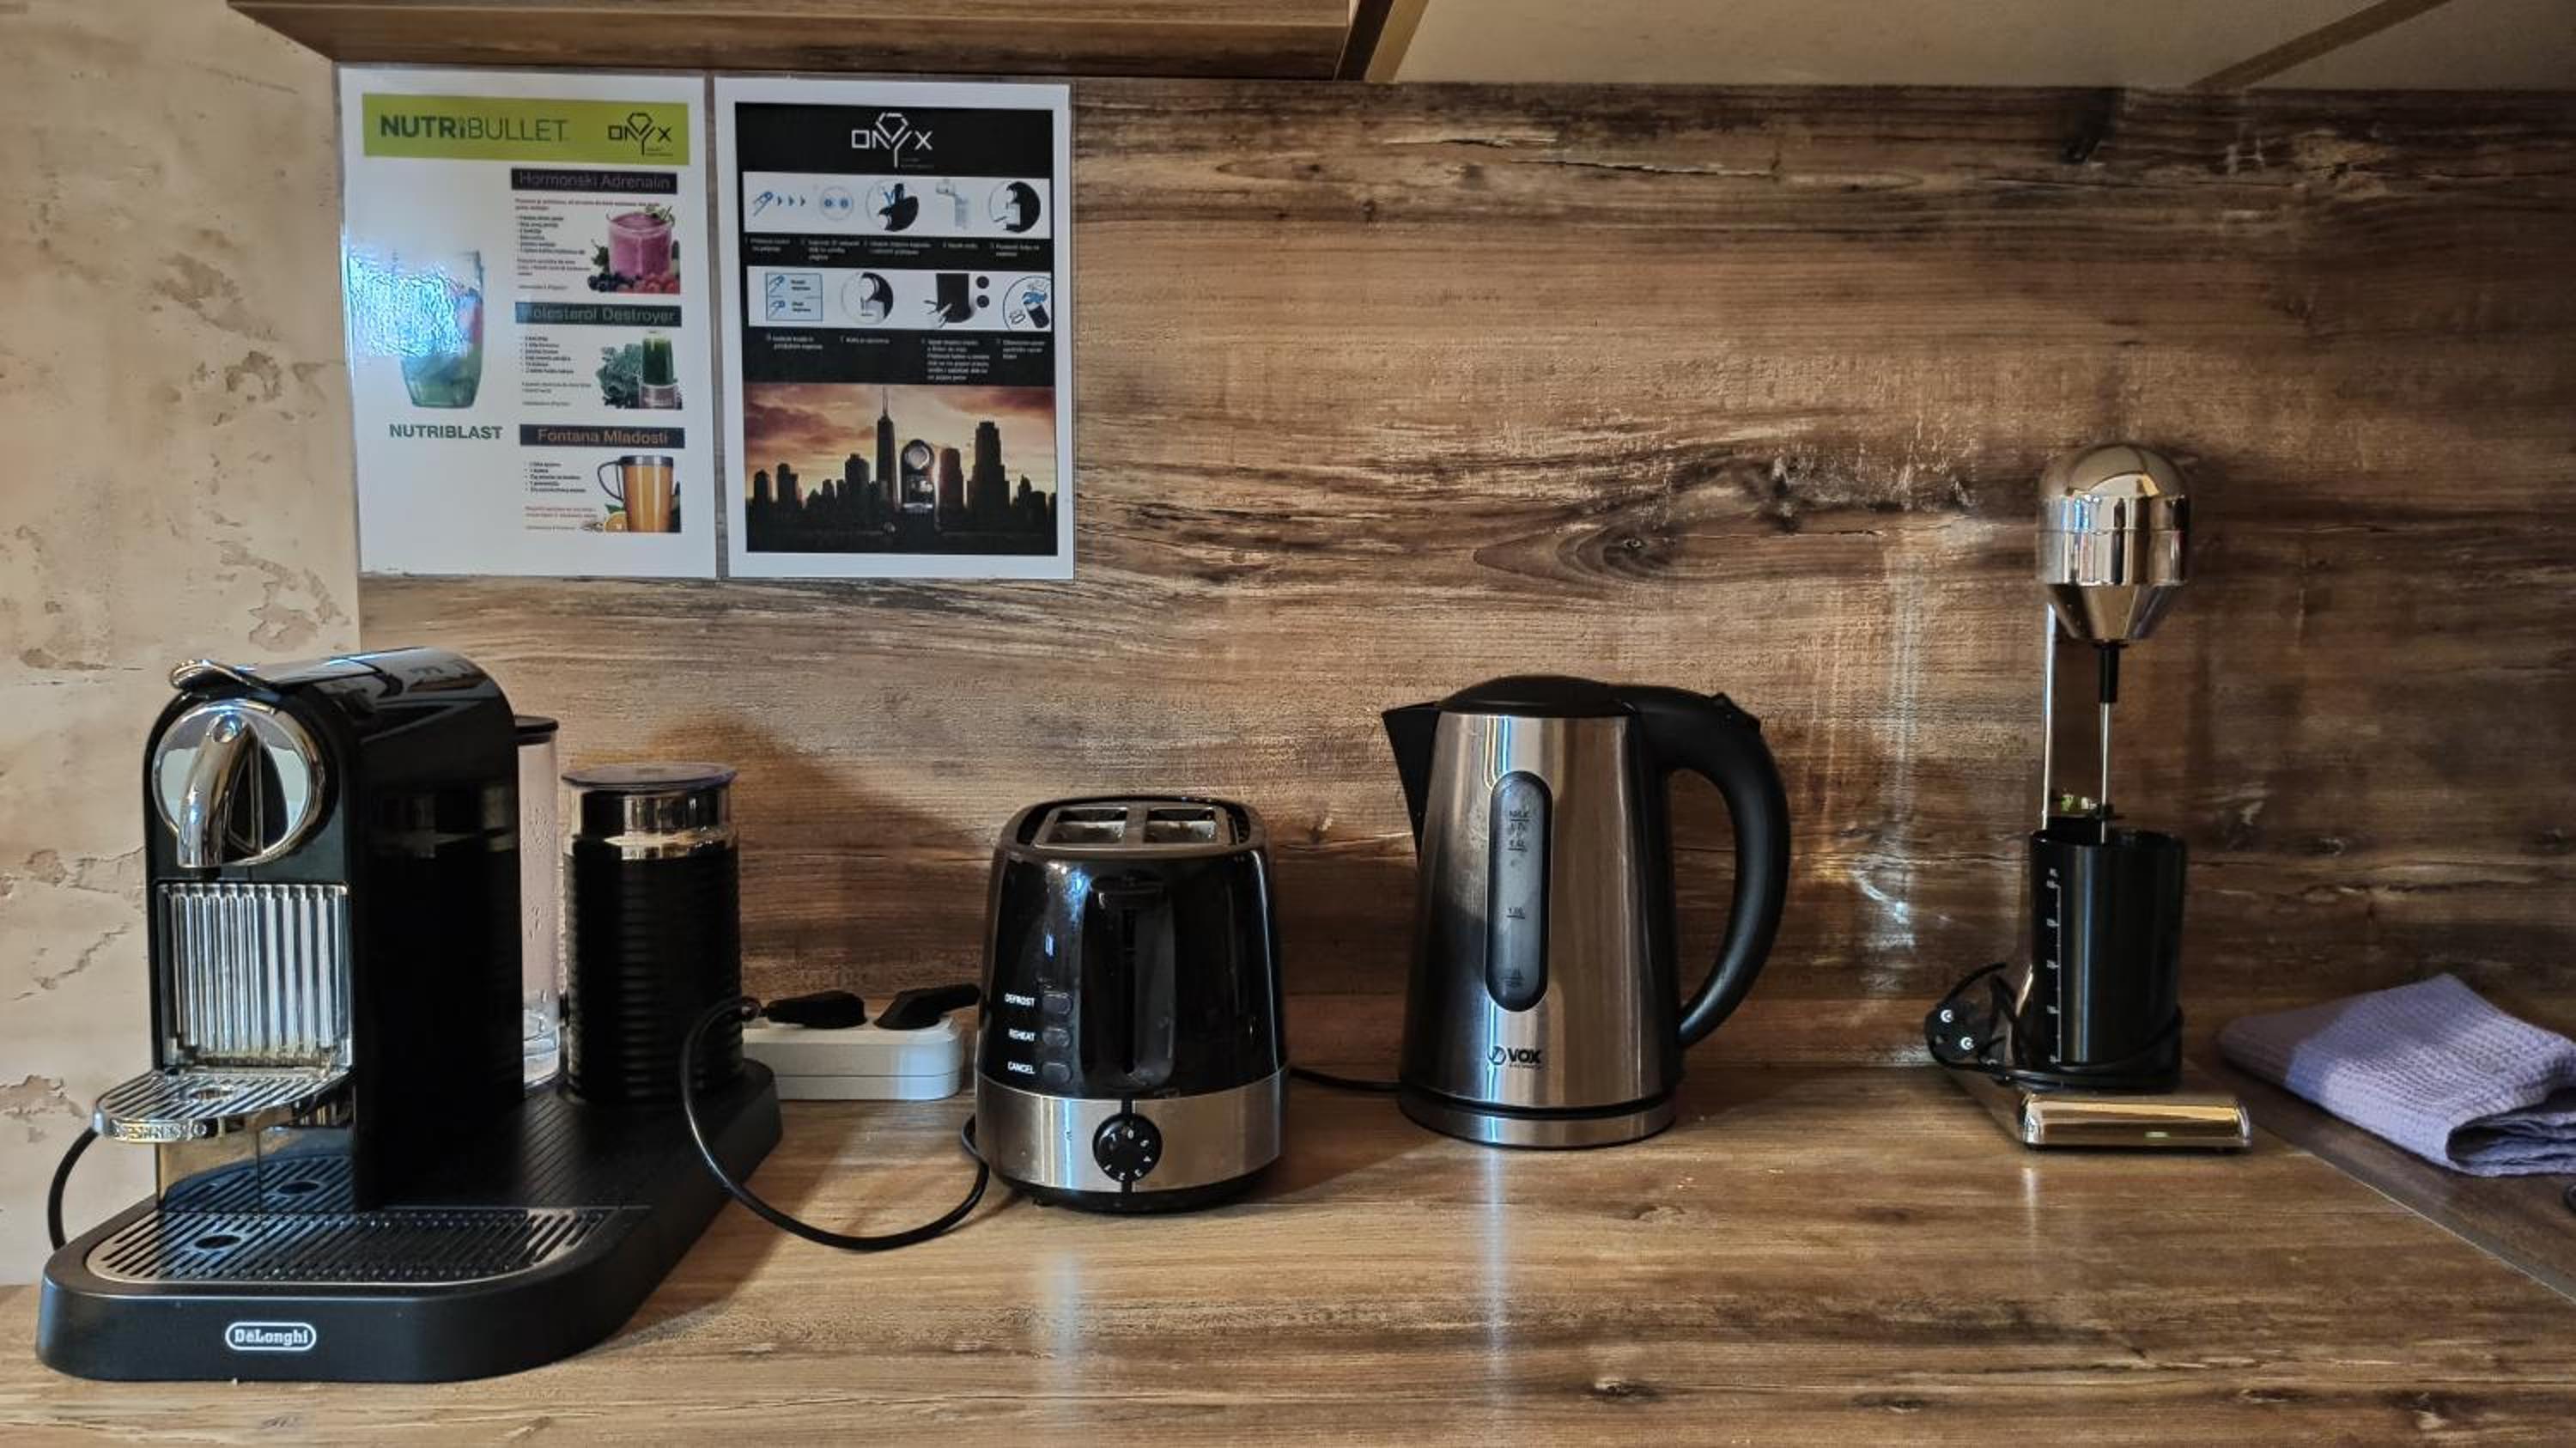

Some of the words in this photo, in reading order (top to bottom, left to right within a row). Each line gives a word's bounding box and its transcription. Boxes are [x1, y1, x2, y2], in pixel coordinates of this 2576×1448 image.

[851, 112, 933, 168] ONYX
[602, 173, 671, 190] Adrenalin
[602, 307, 675, 324] Destroyer
[389, 423, 503, 441] NUTRIBLAST
[537, 428, 599, 443] Fontana
[604, 429, 668, 445] Mladosti
[1004, 993, 1035, 1007] DEFROST
[1008, 1028, 1036, 1042] REHEAT
[1507, 1047, 1542, 1064] VOX
[1007, 1061, 1036, 1074] CANCEL
